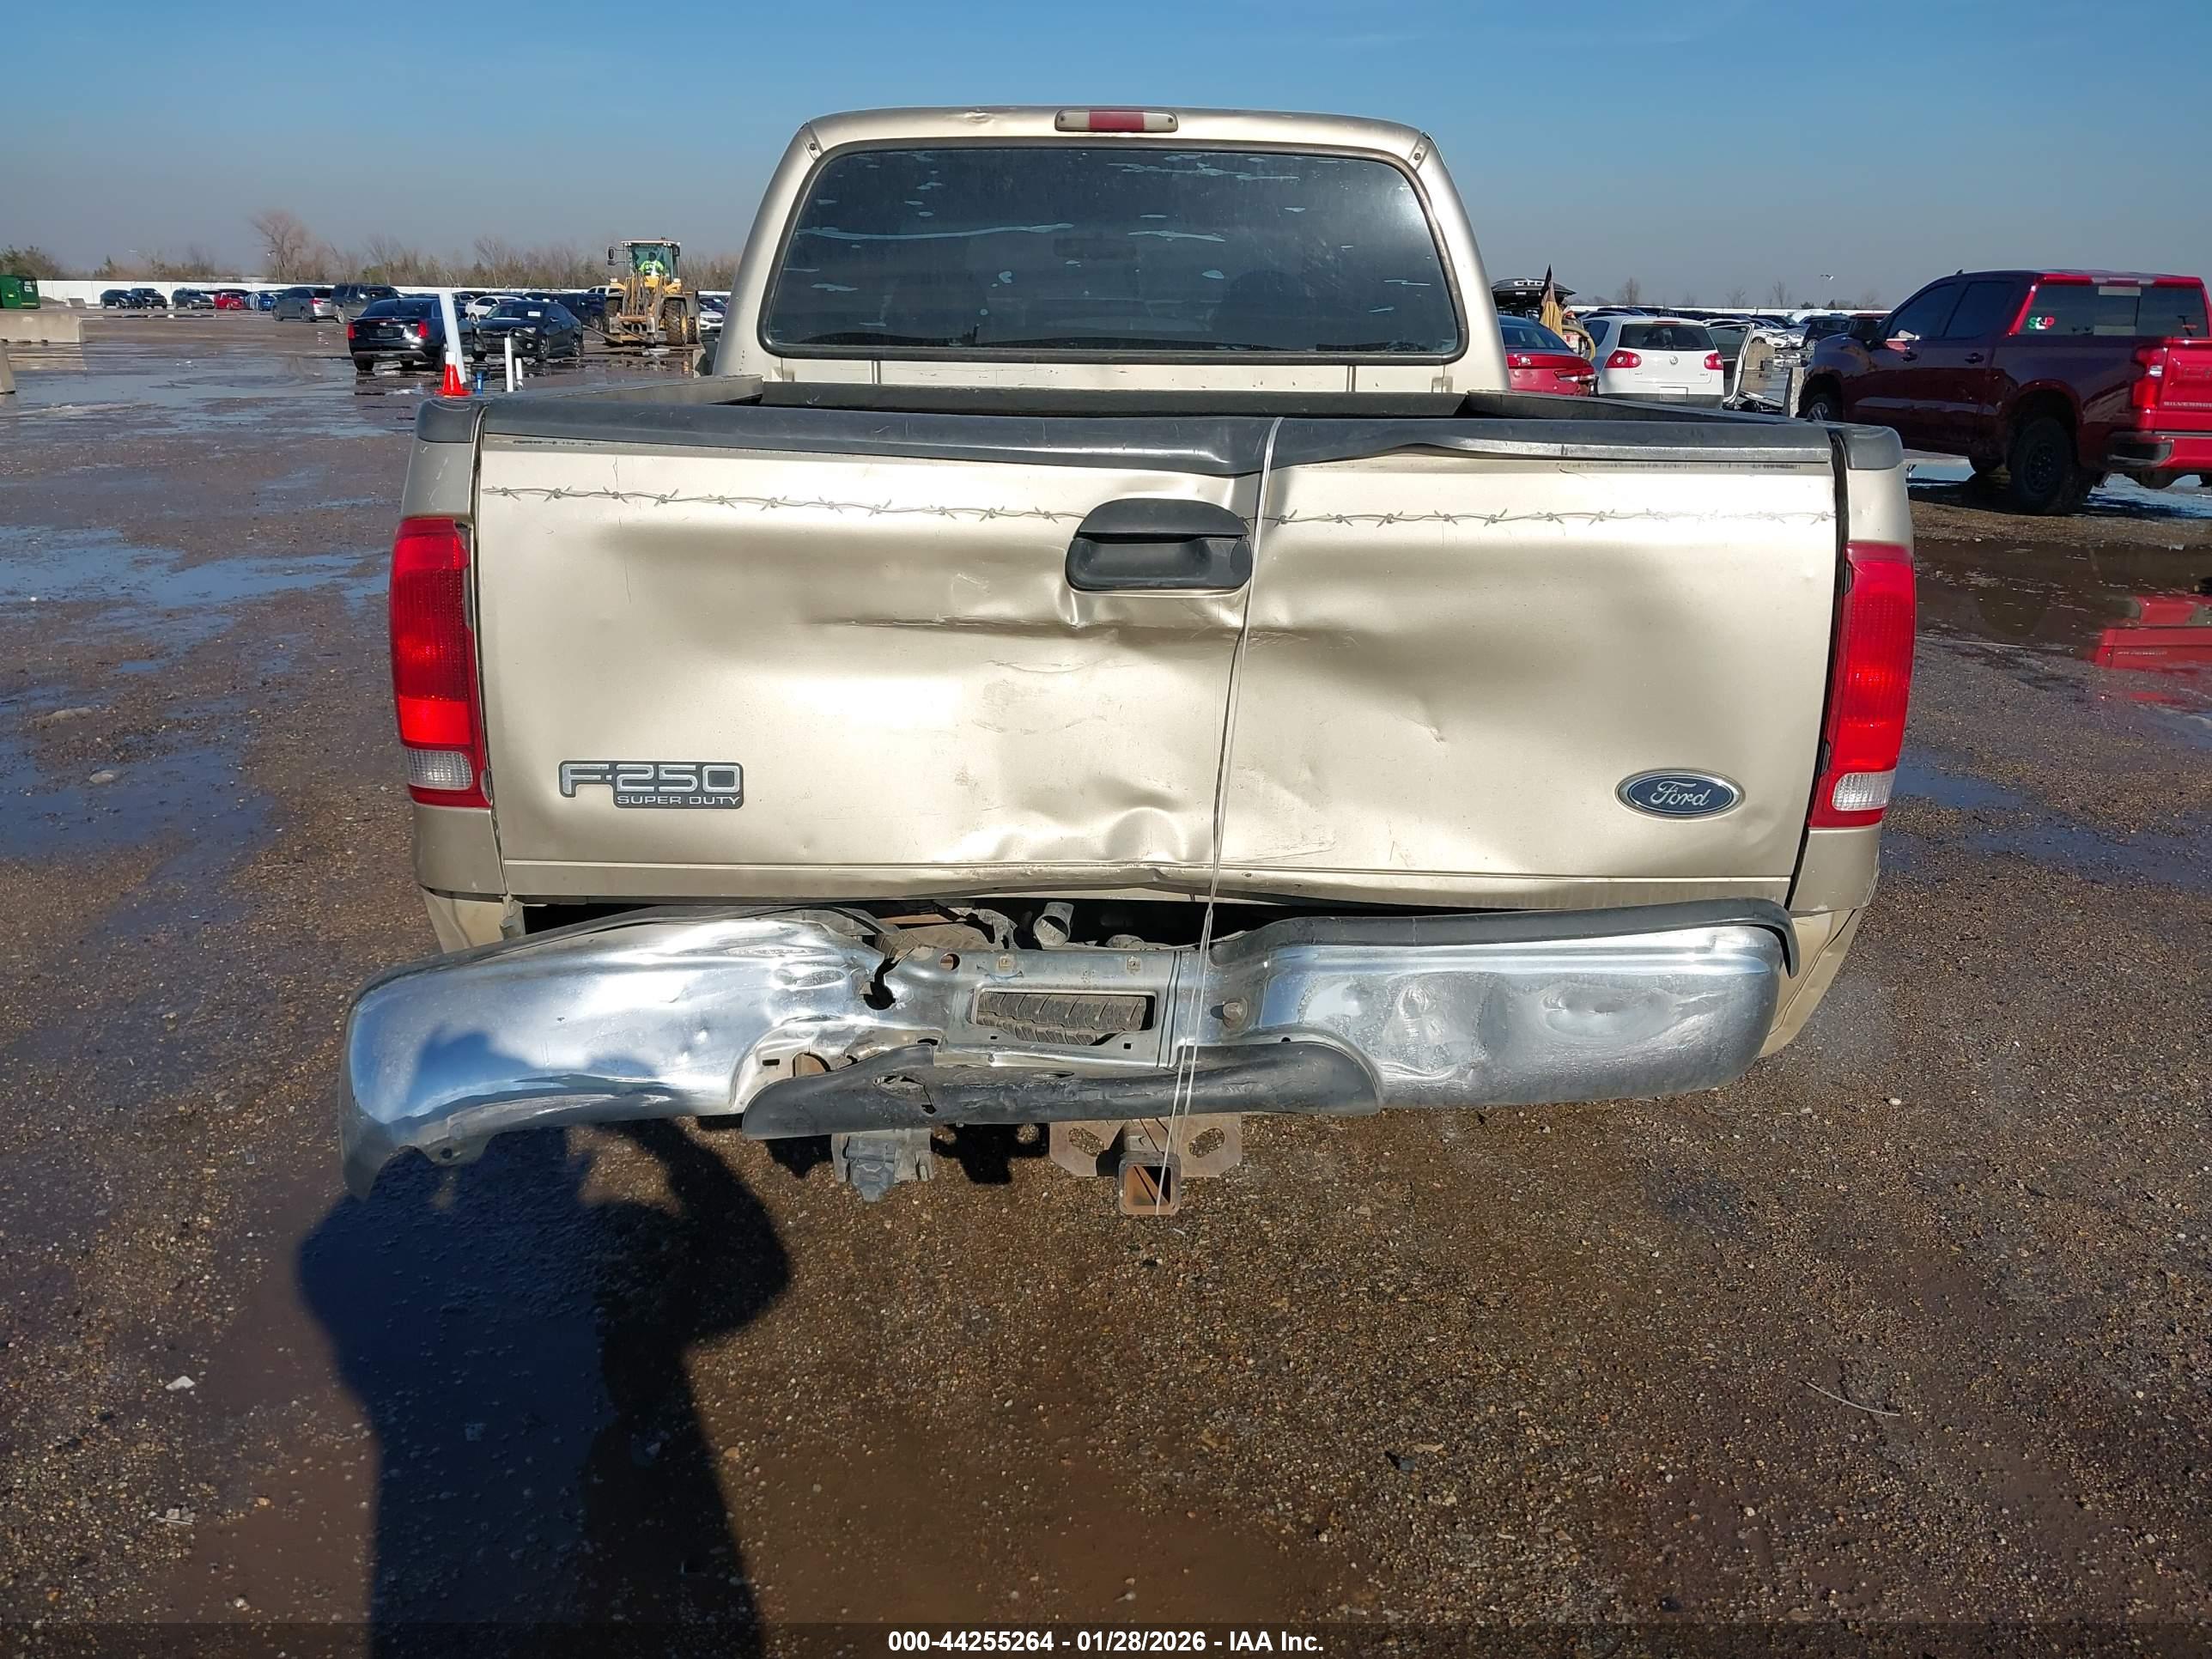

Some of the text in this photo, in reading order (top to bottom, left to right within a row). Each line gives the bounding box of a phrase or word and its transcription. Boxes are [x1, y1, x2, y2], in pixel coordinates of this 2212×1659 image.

[562, 763, 740, 795] F-250
[617, 795, 740, 805] SUPER DUTY
[1650, 781, 1711, 806] Ford
